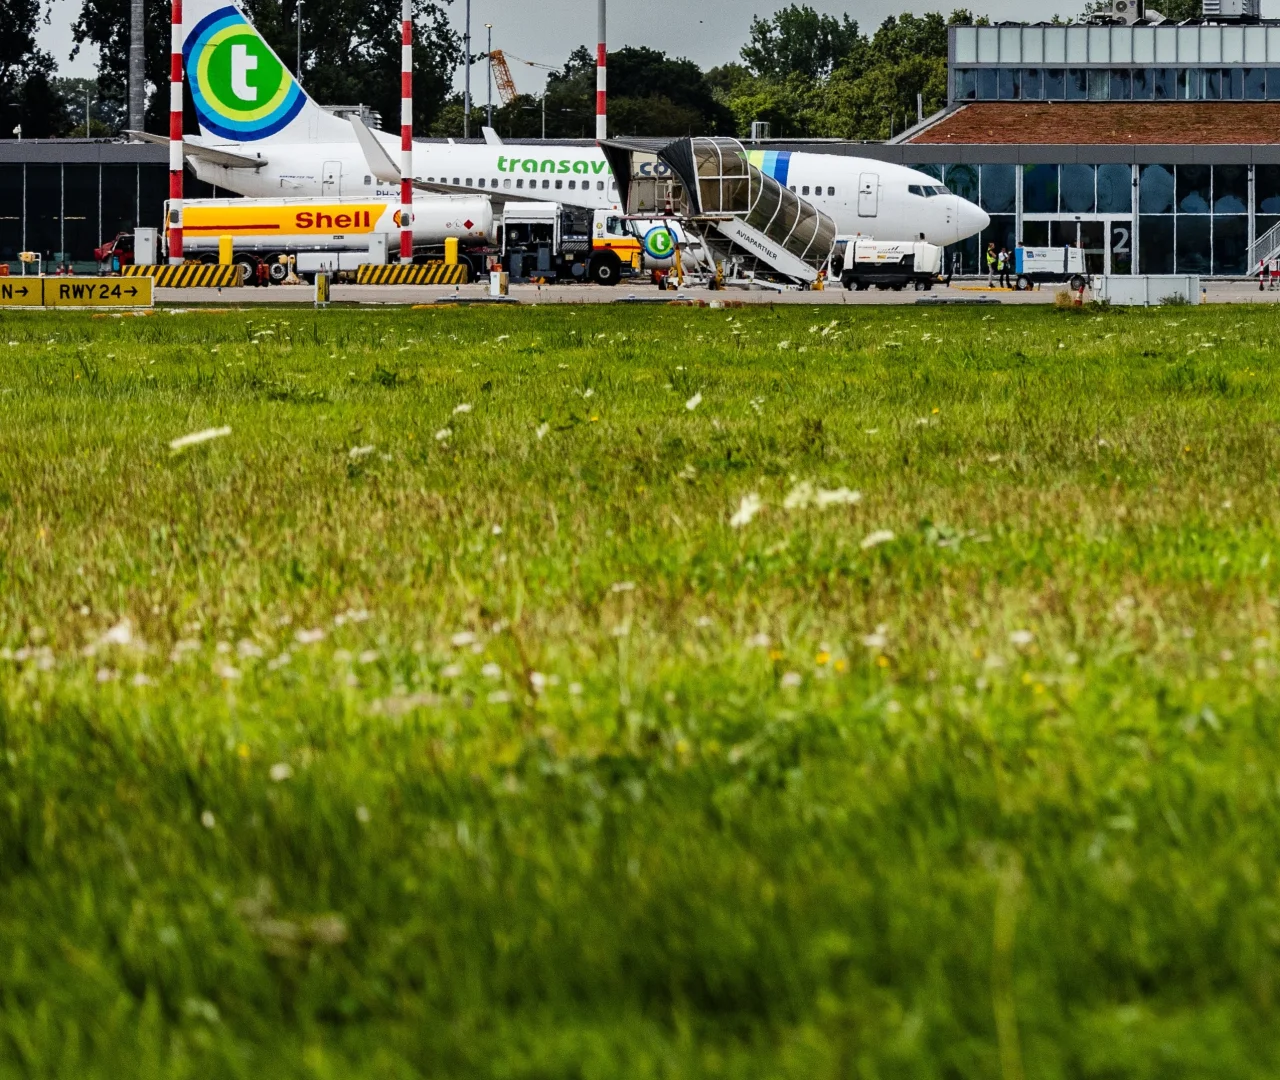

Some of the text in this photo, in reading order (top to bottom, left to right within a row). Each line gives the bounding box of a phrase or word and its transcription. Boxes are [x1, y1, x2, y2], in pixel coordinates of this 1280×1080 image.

[295, 211, 370, 229] Shell
[736, 229, 778, 260] AVIAPARTNER
[1113, 228, 1129, 253] 2
[2, 284, 13, 299] N
[59, 284, 122, 299] RWY 24
